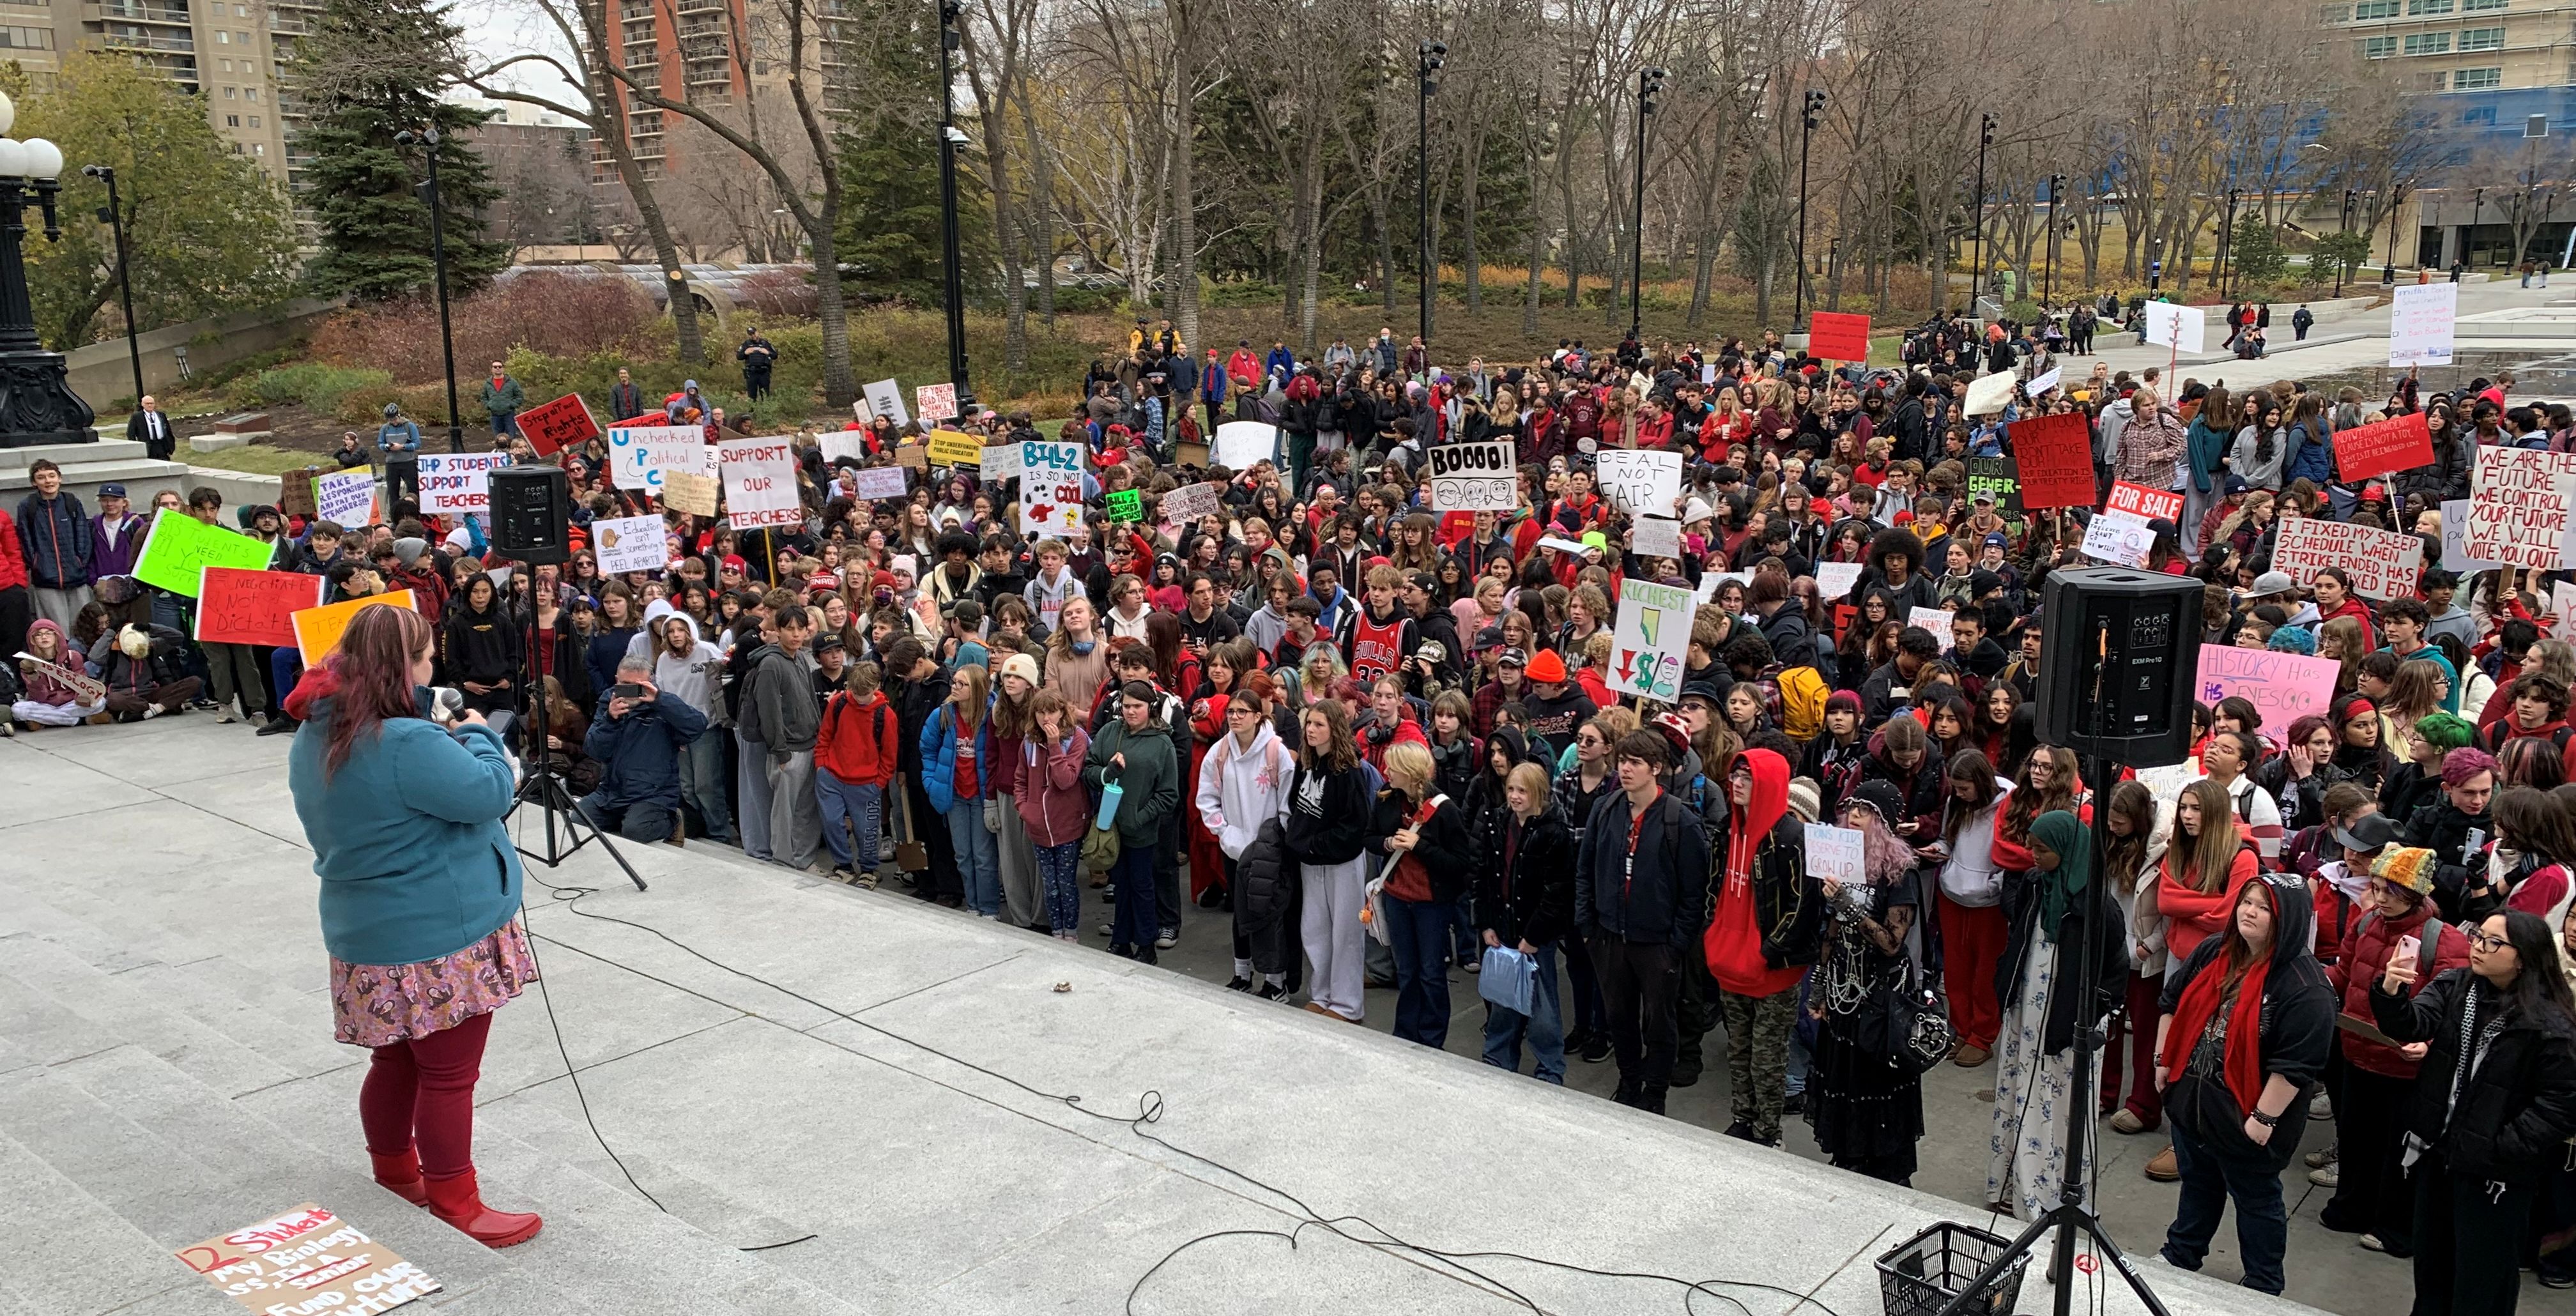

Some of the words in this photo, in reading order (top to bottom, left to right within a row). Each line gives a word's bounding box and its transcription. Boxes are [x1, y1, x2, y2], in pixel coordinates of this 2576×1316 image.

[919, 396, 936, 406] READ
[937, 393, 953, 402] THIS
[542, 414, 585, 438] Rights
[2017, 418, 2046, 432] YOU
[2050, 415, 2082, 427] TOOK
[611, 429, 695, 446] Unchecked
[947, 441, 979, 450] UNDERFUNDING
[2016, 432, 2039, 445] OUR
[2338, 439, 2364, 454] CLAUSE
[2364, 438, 2373, 447] IS
[2373, 432, 2390, 445] NOT
[2391, 432, 2397, 440] A
[636, 448, 689, 466] Political
[721, 445, 787, 463] SUPPORT
[950, 448, 974, 457] EDUCATION
[2055, 443, 2083, 454] TAKE
[2341, 454, 2356, 464] WHY
[2358, 452, 2364, 461] IS
[2364, 450, 2370, 459] IT
[2372, 445, 2392, 457] BEING
[1430, 445, 1508, 476] BOOOO!
[1600, 452, 1678, 469] DEAL
[1970, 457, 2003, 475] OUR
[2019, 457, 2044, 468] OUR
[2344, 461, 2359, 471] ONE?
[2478, 447, 2508, 467] WE
[2511, 450, 2543, 471] ARE
[2547, 452, 2576, 474] THE
[1029, 471, 1041, 480] IS
[1046, 471, 1059, 480] SO
[1064, 472, 1080, 481] NOT
[1618, 468, 1664, 480] NOT
[2021, 470, 2034, 478] OUR
[2081, 467, 2090, 475] IS
[2022, 478, 2038, 486] OUR
[2071, 476, 2094, 485] RIGHT
[2483, 466, 2555, 491] FUTURE
[320, 476, 351, 491] TAKE
[418, 475, 471, 491] SUPPORT
[744, 477, 772, 491] OUR
[1055, 485, 1084, 505] COOL
[1107, 494, 1127, 505] BILL
[1129, 493, 1135, 502] 2
[1166, 495, 1200, 512] STUDENTS
[1200, 493, 1215, 501] FIRST
[1600, 482, 1654, 508] FAIR
[2110, 485, 2140, 510] FOR
[2141, 493, 2181, 519] SALE
[2472, 486, 2498, 503] WE
[2502, 488, 2568, 512] CONTROL
[321, 503, 334, 512] AND
[1108, 503, 1138, 515] RUSHED
[1199, 503, 1216, 514] LAST
[729, 508, 801, 526] TEACHERS
[2470, 503, 2509, 524] YOUR
[2512, 507, 2568, 532] FUTURE
[624, 519, 662, 535] Education
[2281, 520, 2294, 533] I
[2301, 521, 2349, 538] FIXED
[2354, 528, 2373, 540] MY
[2377, 532, 2418, 551] SLEEP
[2469, 521, 2501, 541] WE
[2508, 525, 2559, 549] WILL
[195, 544, 222, 561] NEED
[626, 542, 658, 553] something
[2279, 535, 2355, 554] SCHEDULE
[2361, 542, 2400, 563] WHEN
[2464, 540, 2496, 560] VOTE
[2499, 544, 2525, 563] YOU
[611, 559, 631, 570] PEEL
[2275, 550, 2333, 567] STRIKE
[2386, 565, 2414, 581] HAS
[1621, 580, 1690, 613] RICHEST
[1354, 641, 1395, 669] BULLS
[2207, 648, 2281, 680] HISTORY
[2288, 662, 2320, 680] Has
[41, 662, 103, 700] IDEOLOGY
[2204, 682, 2223, 701] its
[1806, 826, 1833, 840] TRANS
[1839, 831, 1862, 846] KIDS
[1807, 839, 1841, 855] DESERVE
[1843, 846, 1859, 859] TO
[1811, 855, 1835, 874] GROW
[1840, 861, 1853, 878] UP
[211, 1261, 263, 1283] My
[262, 1225, 371, 1269] Biology
[265, 1290, 348, 1316] FUND
[353, 1261, 423, 1292] OUR
